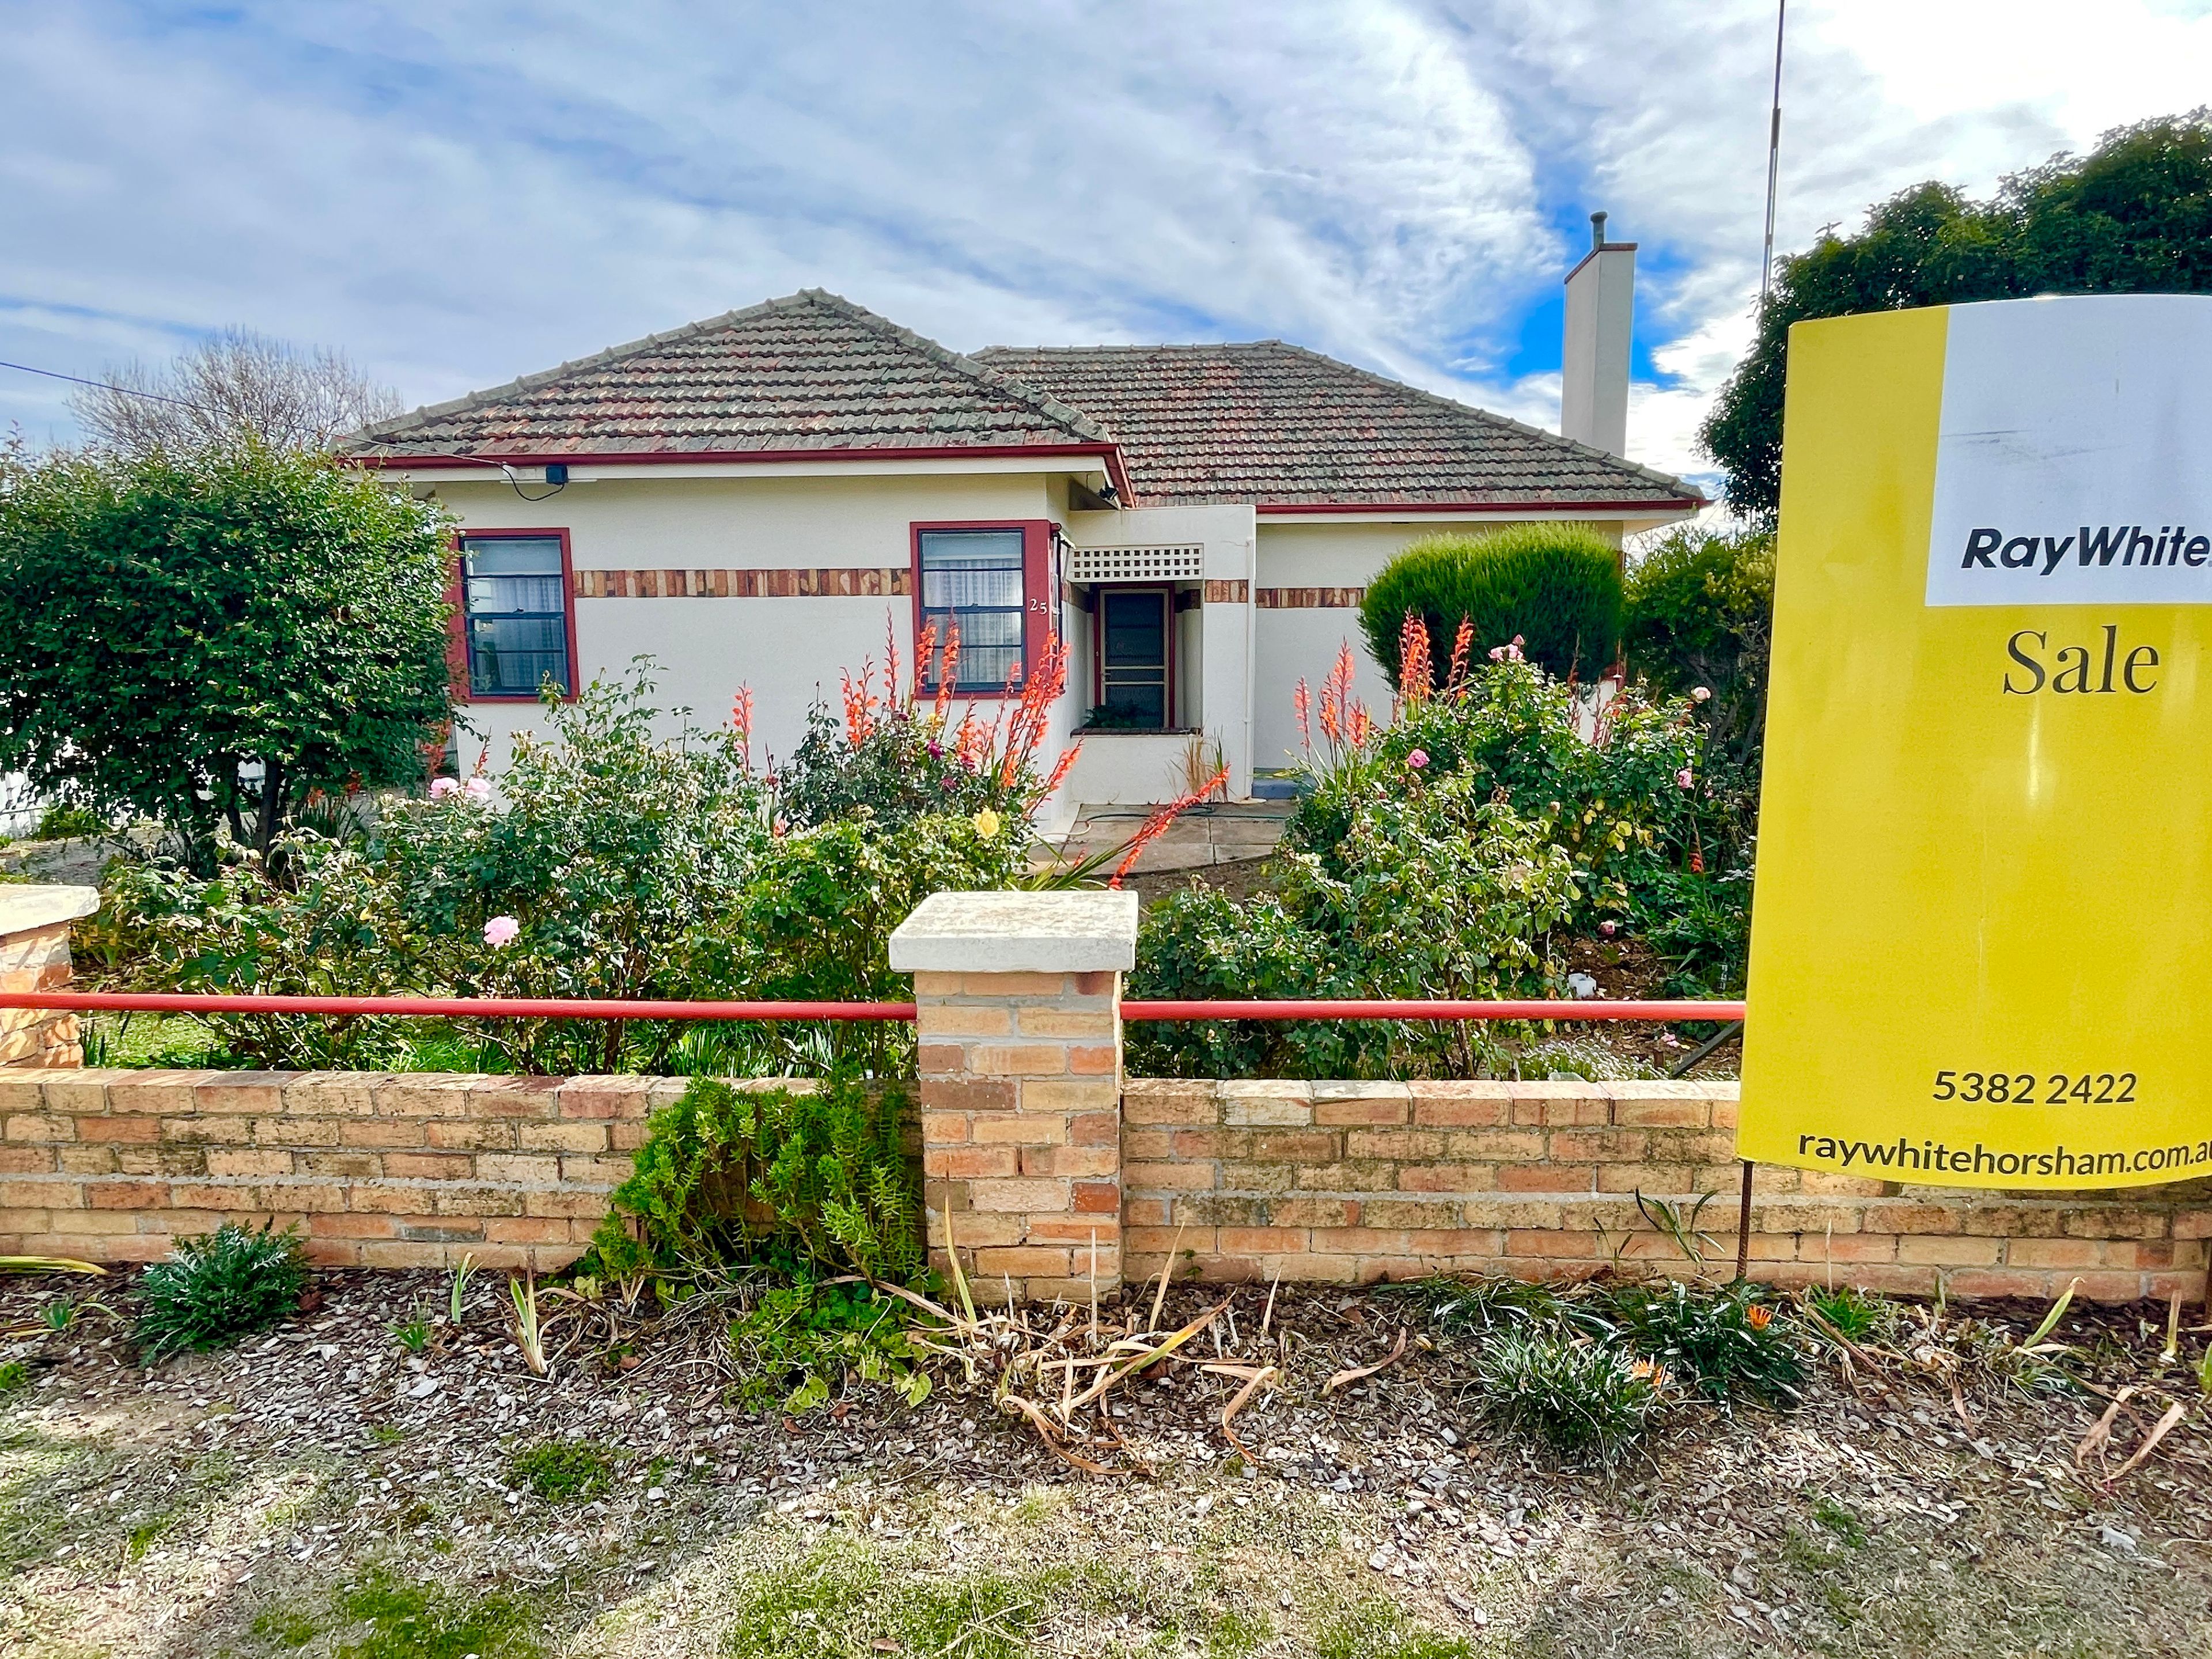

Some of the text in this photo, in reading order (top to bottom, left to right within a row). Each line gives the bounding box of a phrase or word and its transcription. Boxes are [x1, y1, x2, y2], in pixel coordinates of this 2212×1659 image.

[1029, 599, 1047, 615] 25
[2003, 625, 2159, 694] Sale
[1933, 1071, 2137, 1104] 5382 2422
